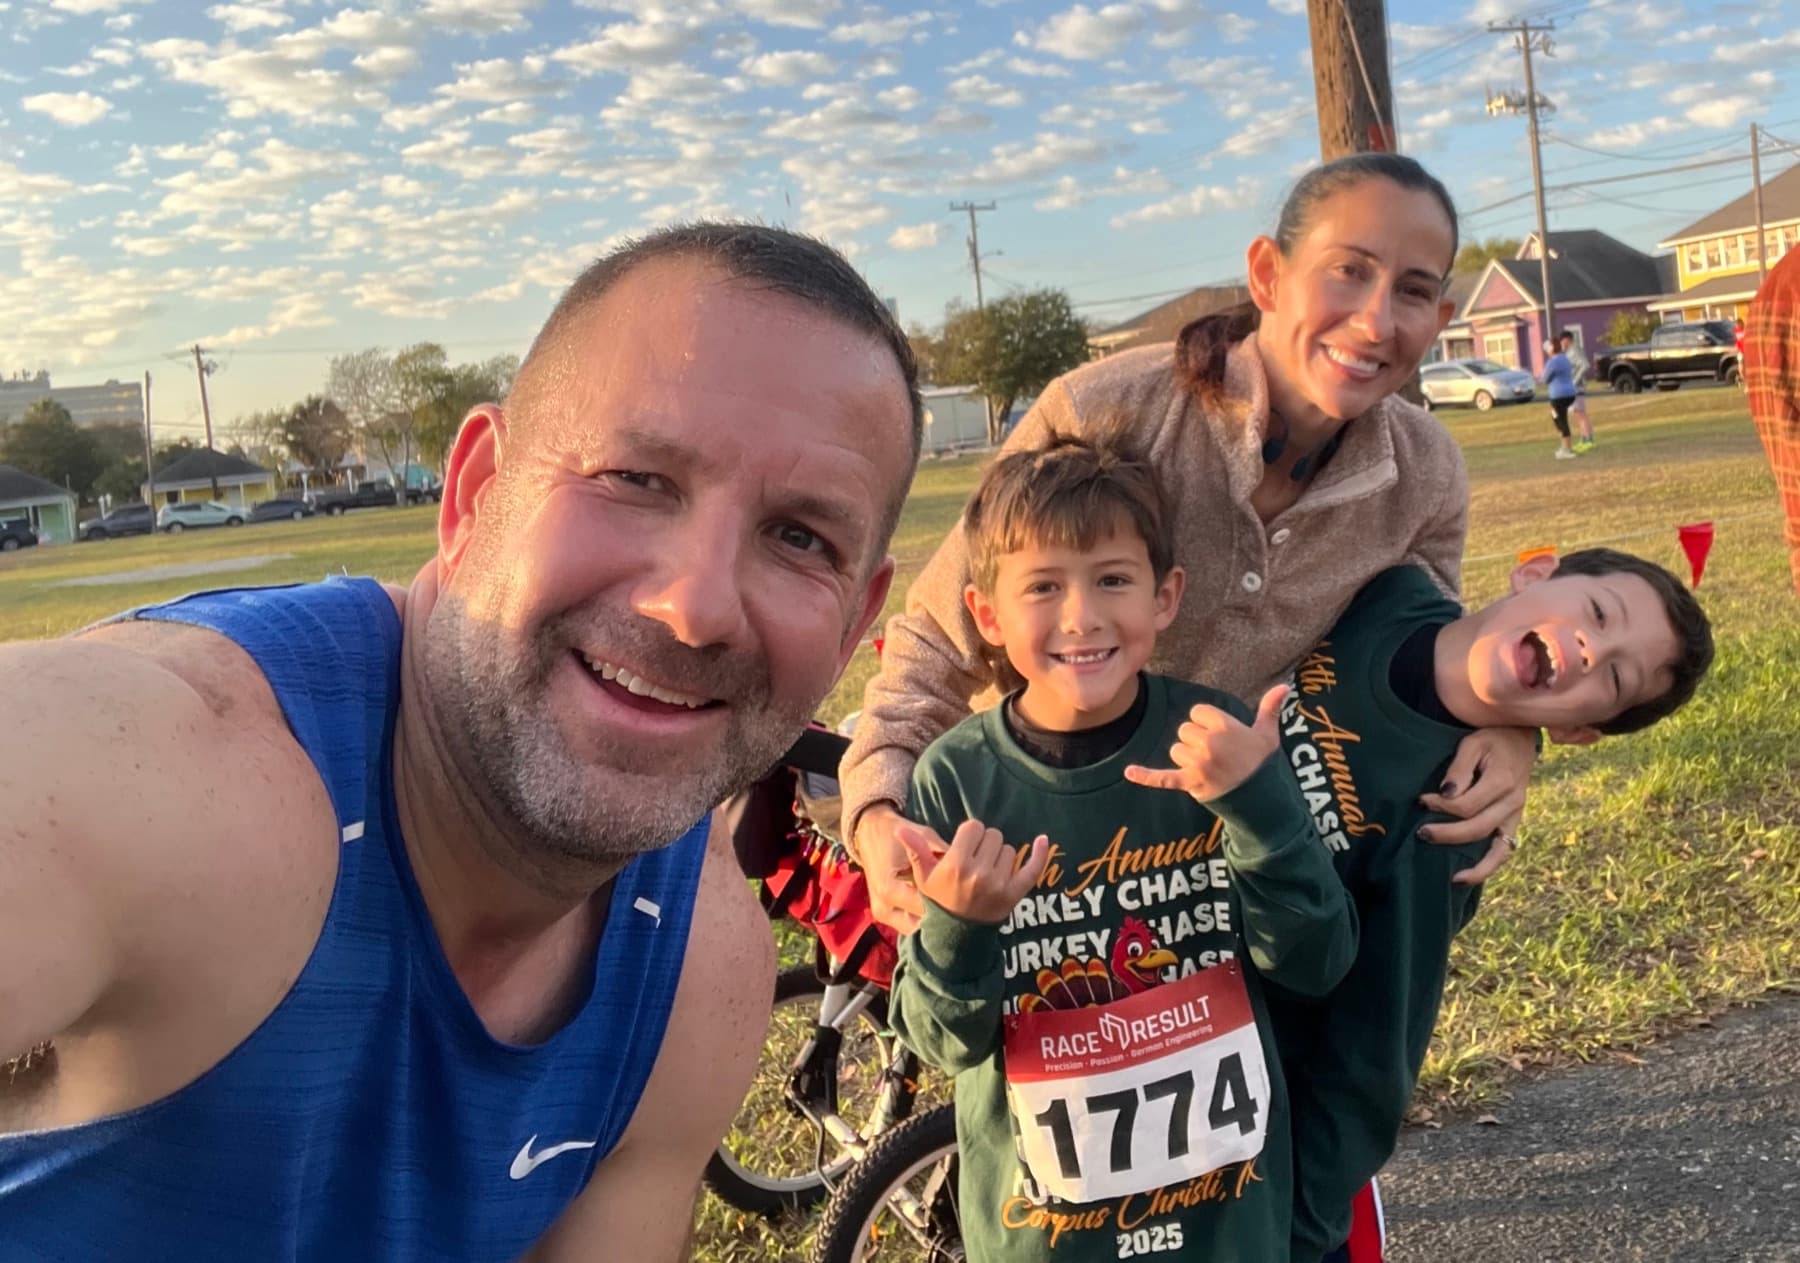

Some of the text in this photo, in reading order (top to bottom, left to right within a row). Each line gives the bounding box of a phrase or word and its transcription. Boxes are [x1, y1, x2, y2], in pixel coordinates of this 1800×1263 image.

[1291, 743, 1351, 856] CHASE
[1297, 700, 1386, 837] Annual
[1065, 816, 1224, 897] Annual
[999, 885, 1106, 935] URKEY
[1117, 859, 1230, 910] CHASE
[1002, 928, 1111, 979] URKEY
[1148, 902, 1231, 948] HASE
[1040, 996, 1211, 1060] RACE RESULT
[1045, 1024, 1213, 1073] Precision Passion German Engineering
[1035, 1052, 1259, 1180] 1774
[1002, 1196, 1110, 1249] Corpus
[1116, 1223, 1184, 1260] 2025
